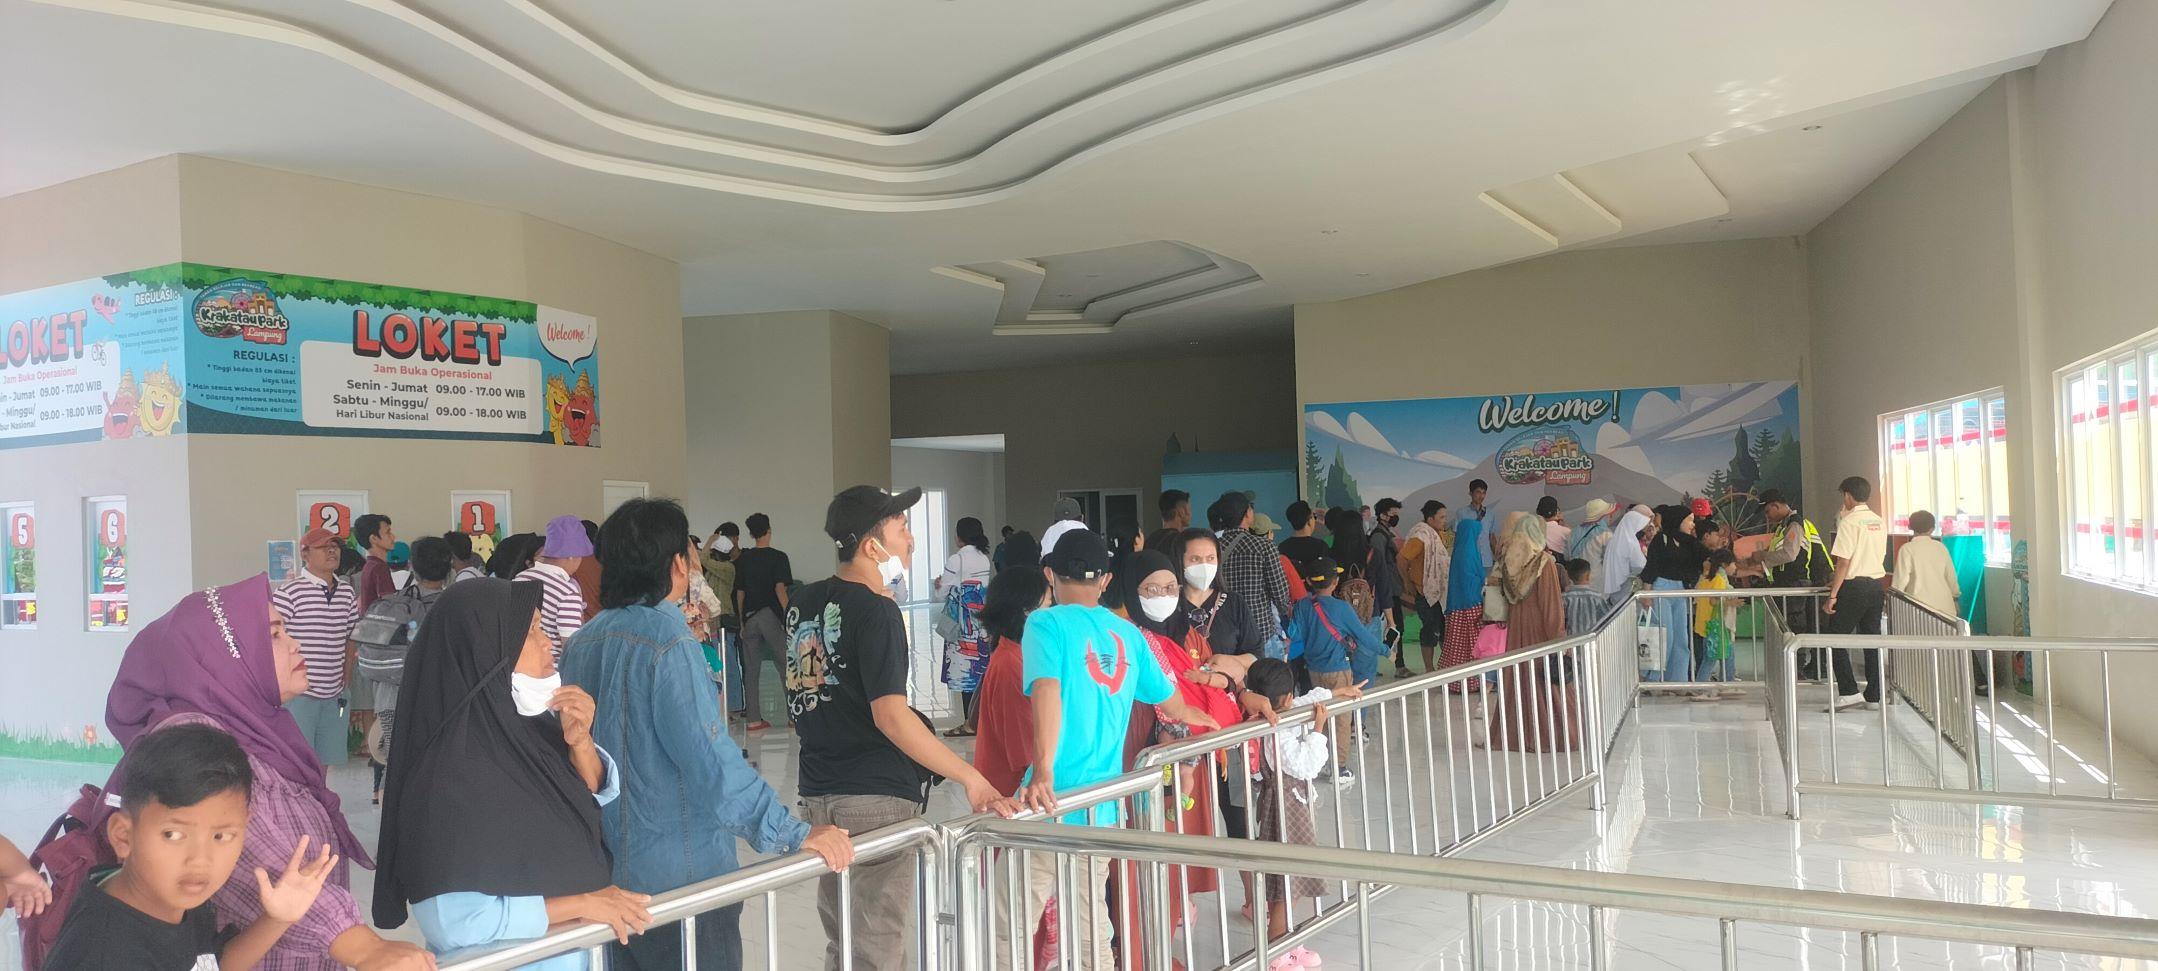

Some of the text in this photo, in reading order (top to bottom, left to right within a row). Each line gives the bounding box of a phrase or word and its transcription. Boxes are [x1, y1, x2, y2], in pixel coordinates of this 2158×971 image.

[135, 289, 173, 306] REGULASI
[247, 327, 282, 342] Lampung
[352, 309, 506, 366] LOKET
[547, 322, 585, 343] Welcome
[233, 350, 288, 363] REGULASI
[3, 366, 78, 385] Jam Buka Operasional
[373, 363, 492, 380] Jam Buka Operasional
[40, 385, 60, 397] 09.00
[66, 383, 84, 394] 17.00
[86, 380, 102, 391] WIB
[347, 379, 380, 391] Senin
[391, 382, 428, 393] Jumat
[435, 384, 466, 395] 09.00
[475, 386, 502, 397] 17.00
[505, 387, 526, 399] WIB
[13, 390, 36, 401] Jumat
[333, 394, 369, 406] Sabtu
[380, 397, 429, 410] Minggu/
[40, 409, 60, 421] 09.00
[66, 407, 85, 418] 18.00
[86, 405, 103, 415] WIB
[336, 408, 429, 421] Hari Libur Nasional
[436, 407, 466, 418] 09.00
[476, 409, 503, 419] 18.00
[505, 409, 527, 420] WIB
[1478, 395, 1609, 433] Welcome
[319, 504, 340, 535] 2
[470, 503, 486, 533] 1
[17, 515, 28, 545] 5
[107, 512, 119, 543] 6
